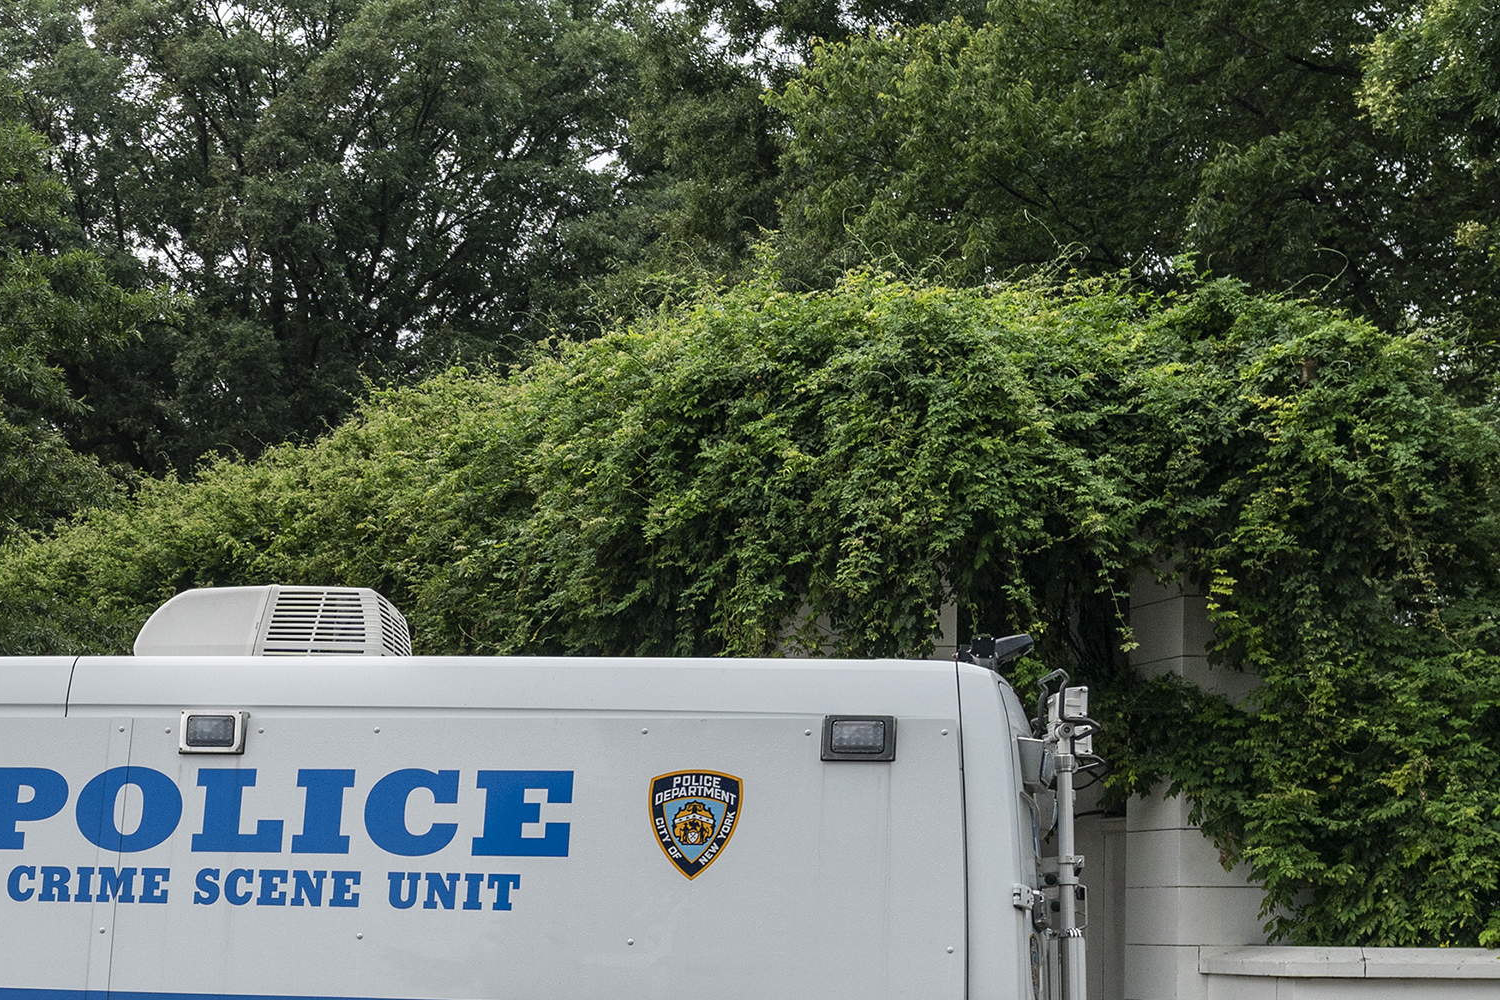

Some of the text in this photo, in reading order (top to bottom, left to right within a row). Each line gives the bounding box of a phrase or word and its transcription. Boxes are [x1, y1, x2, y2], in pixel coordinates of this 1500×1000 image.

[654, 785, 737, 806] DEPARTMENT
[672, 775, 721, 788] POLICE
[655, 811, 736, 866] CITY OF NEW YORK
[7, 865, 521, 911] CRIME SCENE UNIT
